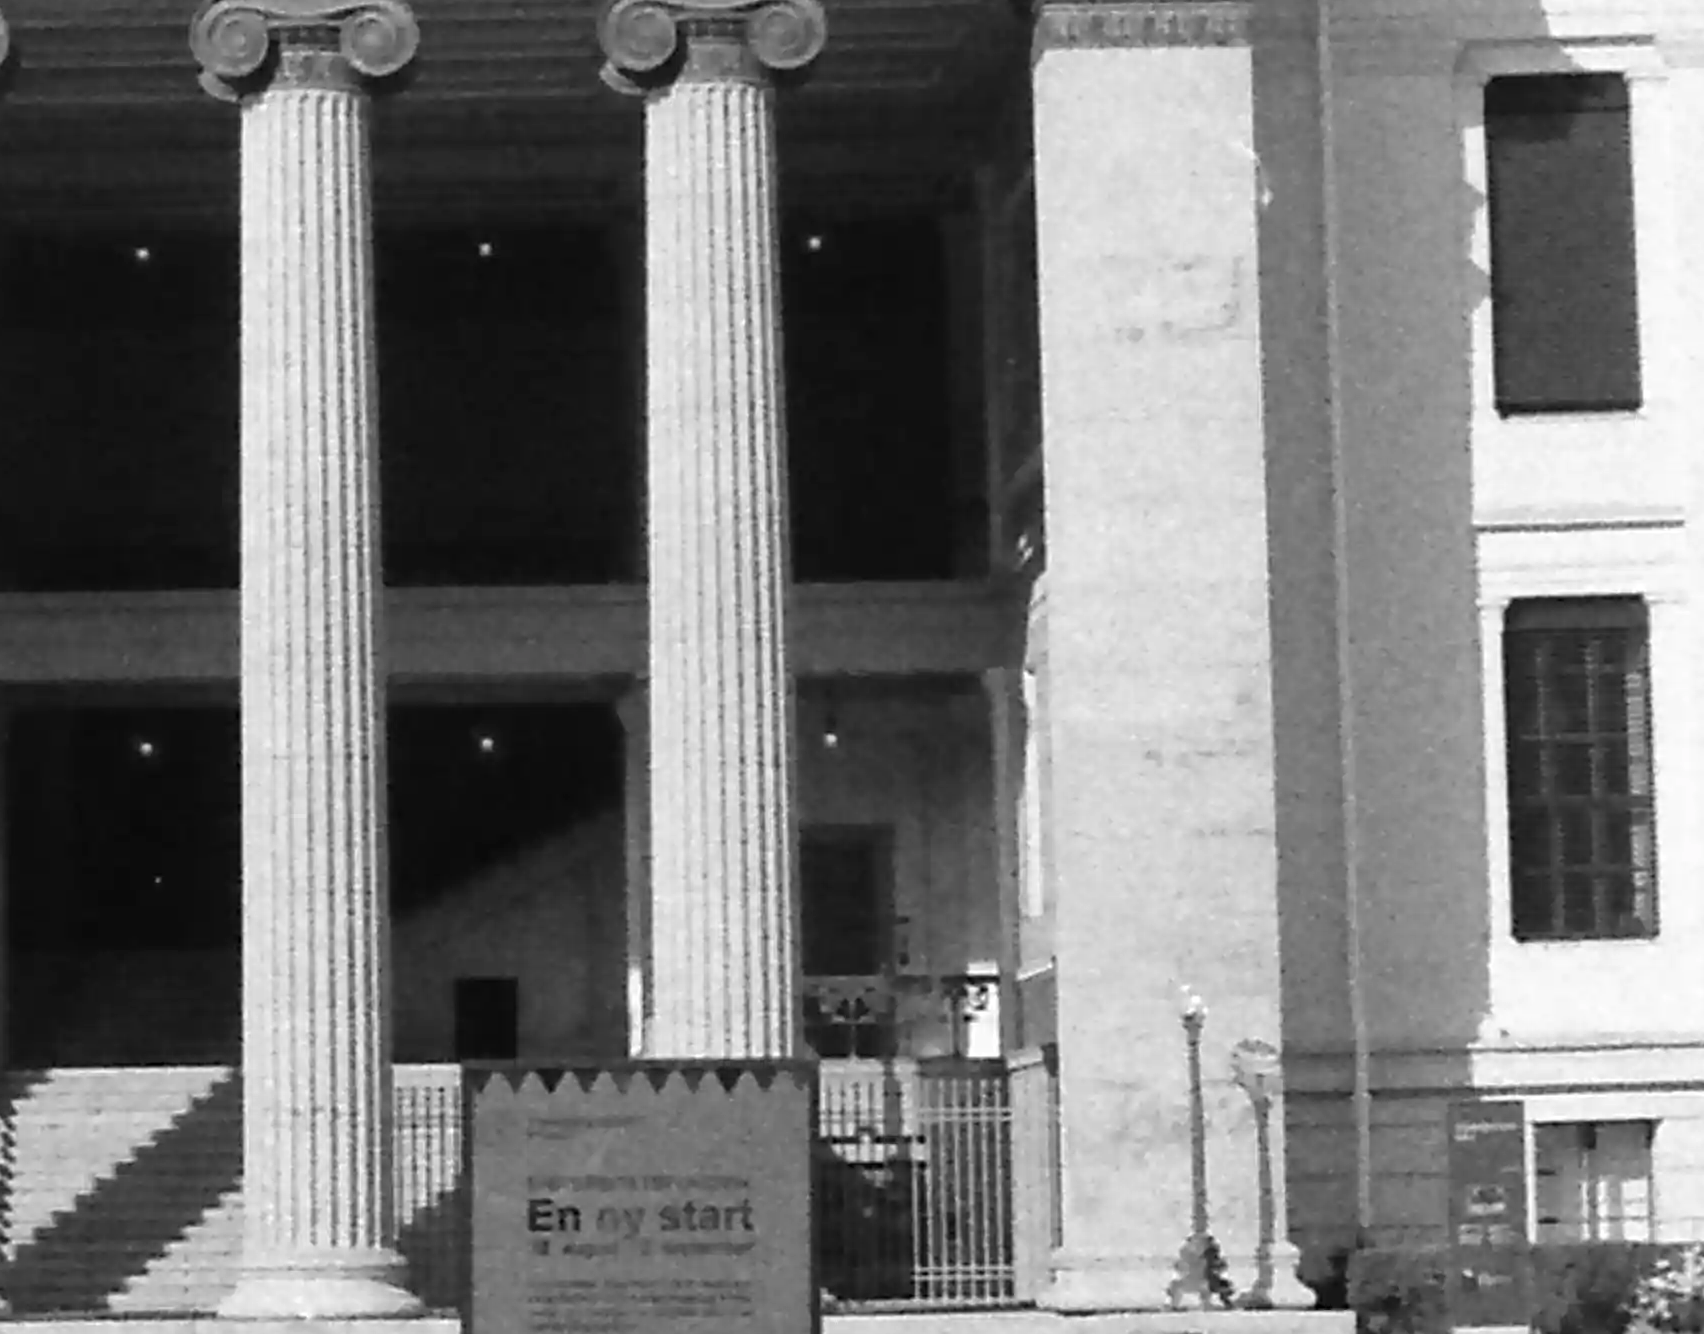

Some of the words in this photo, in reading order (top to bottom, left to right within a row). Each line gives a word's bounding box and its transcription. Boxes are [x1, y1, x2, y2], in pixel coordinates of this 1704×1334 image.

[527, 1198, 582, 1233] En
[595, 1206, 646, 1240] ny
[658, 1199, 754, 1232] start
